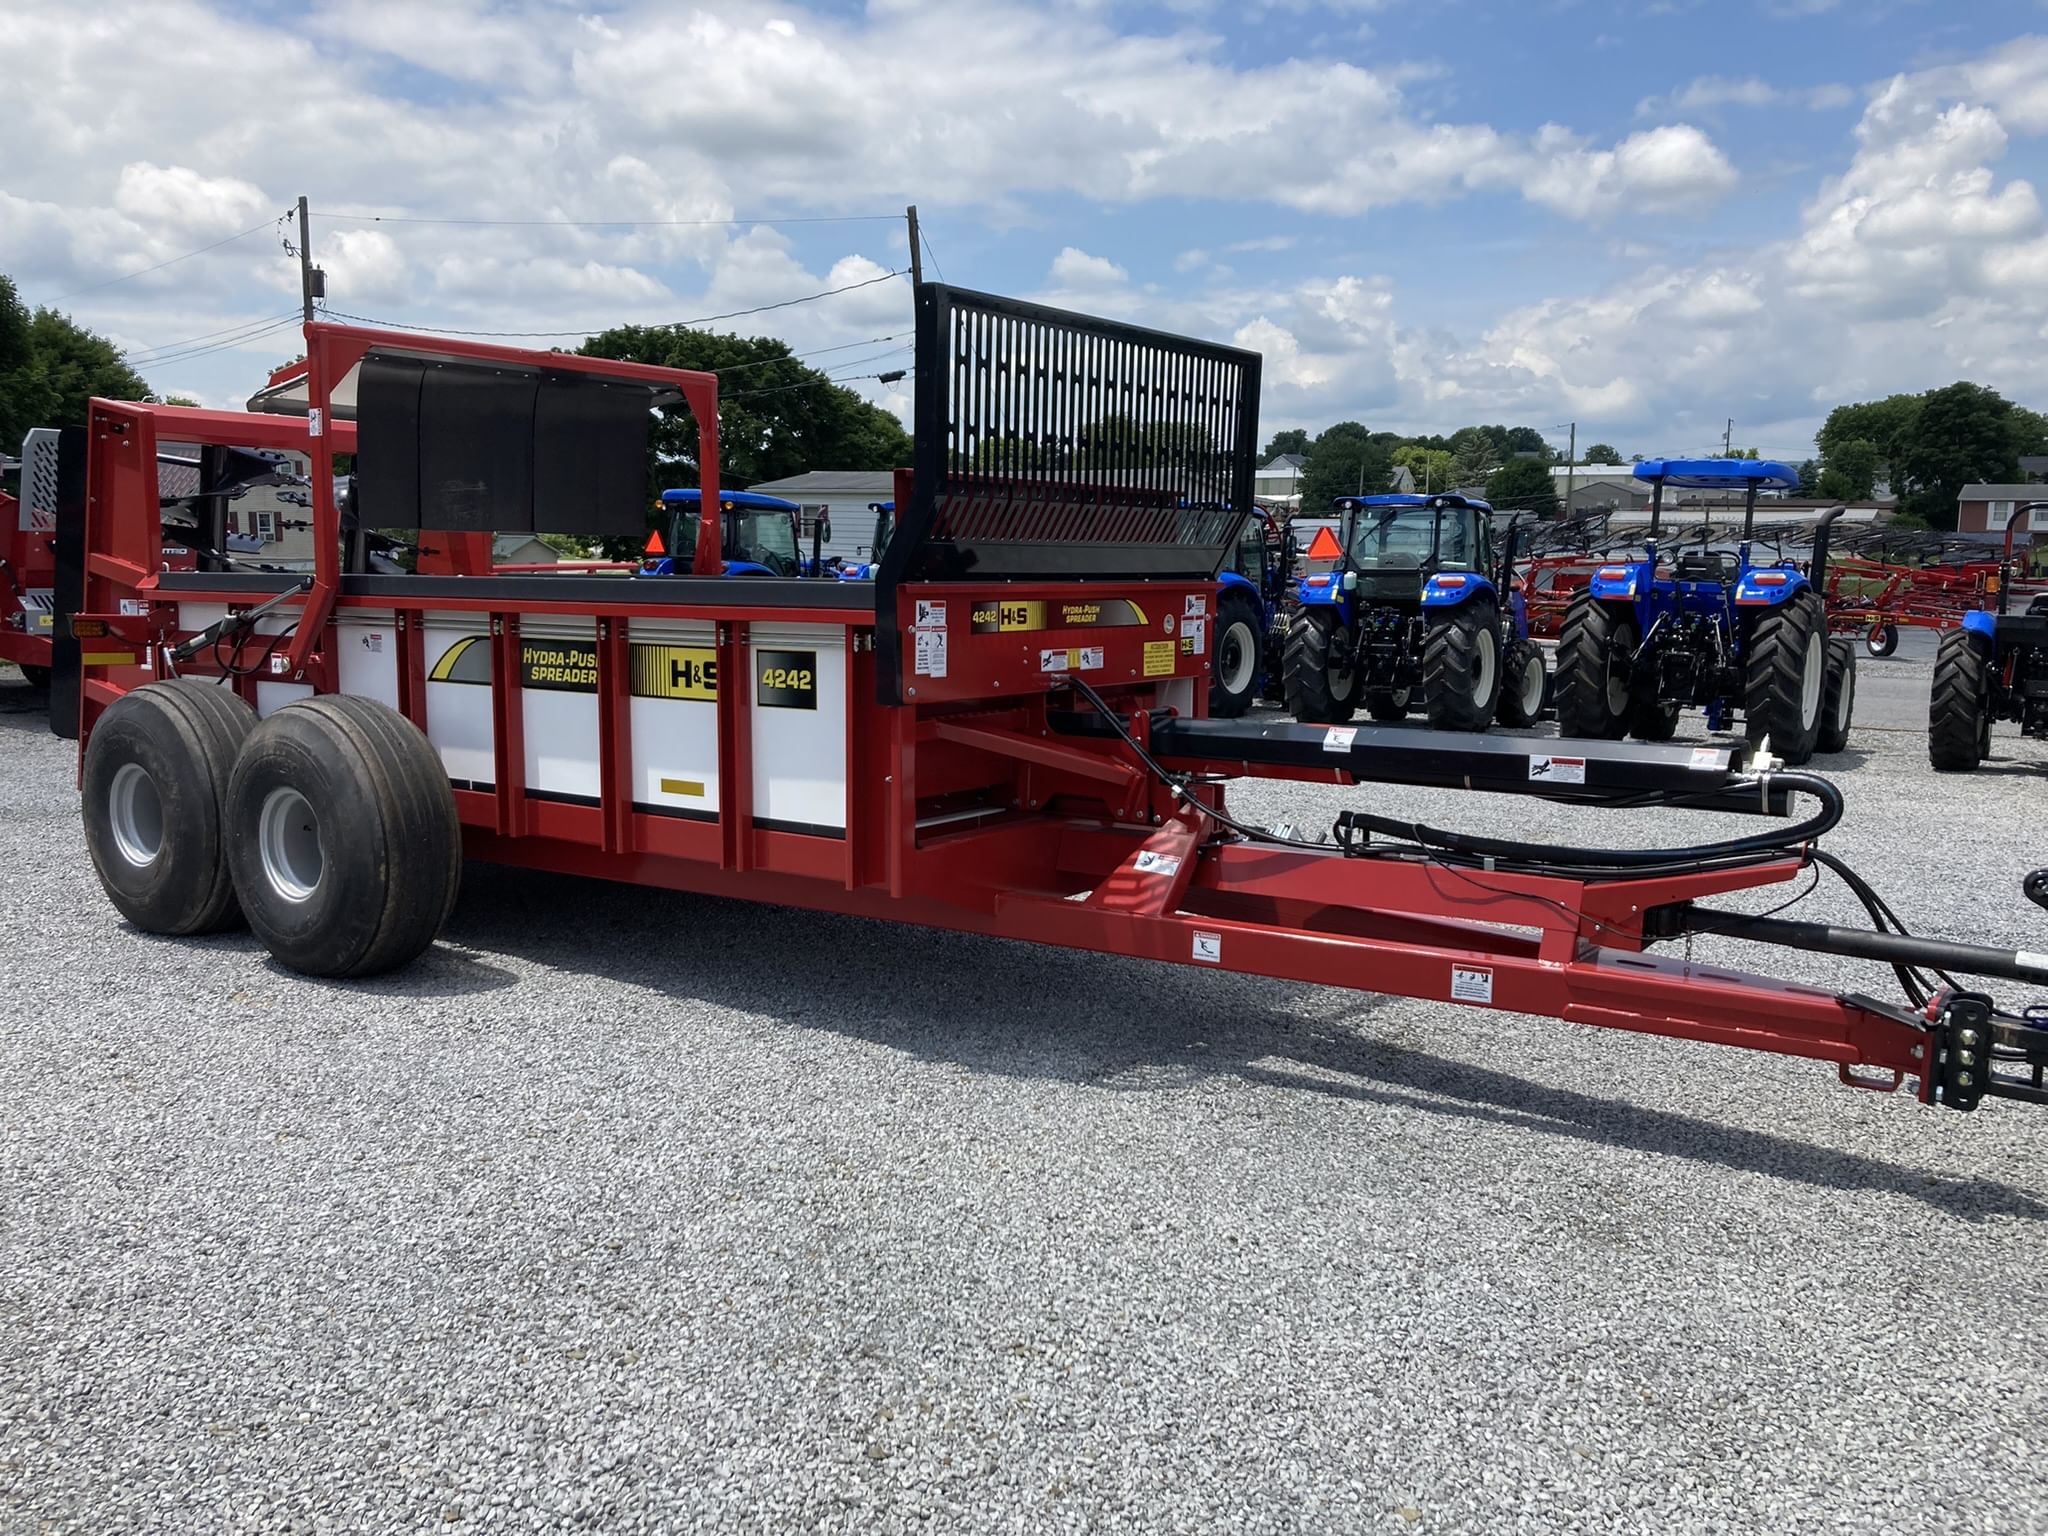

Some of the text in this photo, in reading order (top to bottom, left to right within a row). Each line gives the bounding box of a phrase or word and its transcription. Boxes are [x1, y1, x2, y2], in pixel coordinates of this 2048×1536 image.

[972, 610, 997, 624] 4242
[1000, 607, 1027, 625] H&S
[1065, 614, 1097, 624] SPREADER
[523, 647, 598, 668] HYDRA-PUS
[531, 666, 597, 684] SPREADER
[671, 659, 717, 690] H&S
[762, 668, 812, 690] 4242
